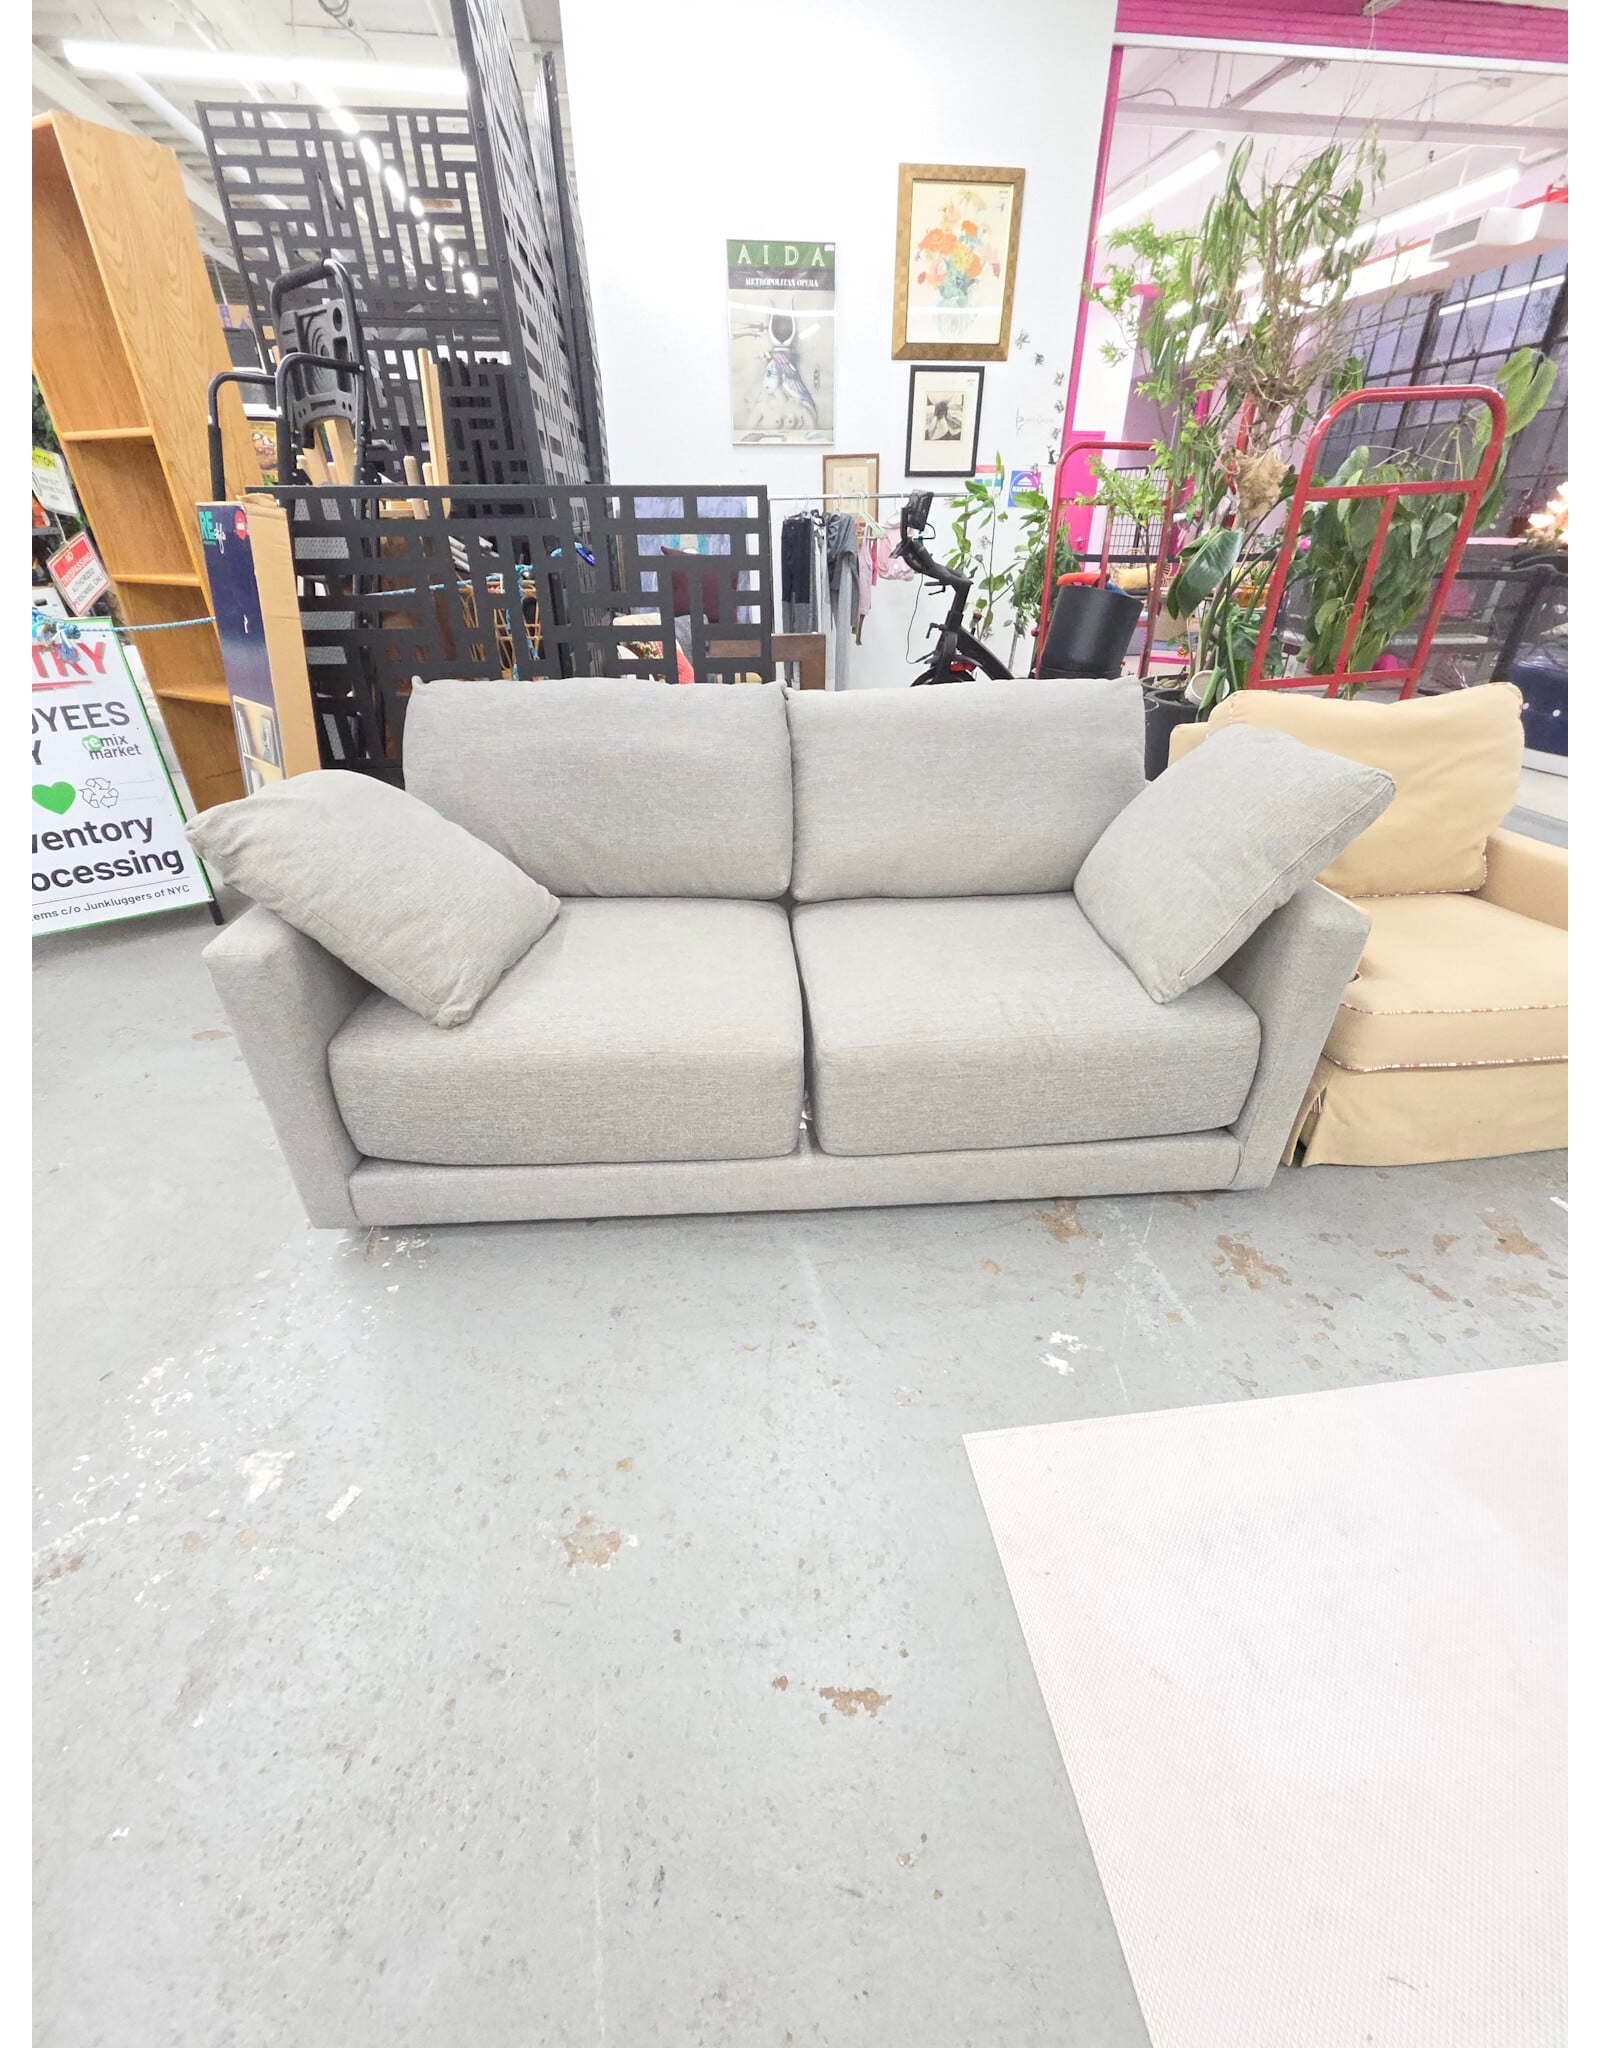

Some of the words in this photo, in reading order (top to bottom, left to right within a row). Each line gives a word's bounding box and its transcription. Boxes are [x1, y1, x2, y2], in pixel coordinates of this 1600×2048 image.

[737, 244, 825, 266] AIDA
[89, 744, 141, 760] market
[32, 910, 59, 921] ems
[61, 905, 81, 915] c/o
[84, 893, 152, 911] Junkluggers
[154, 888, 166, 898] of
[168, 884, 190, 896] NYC
